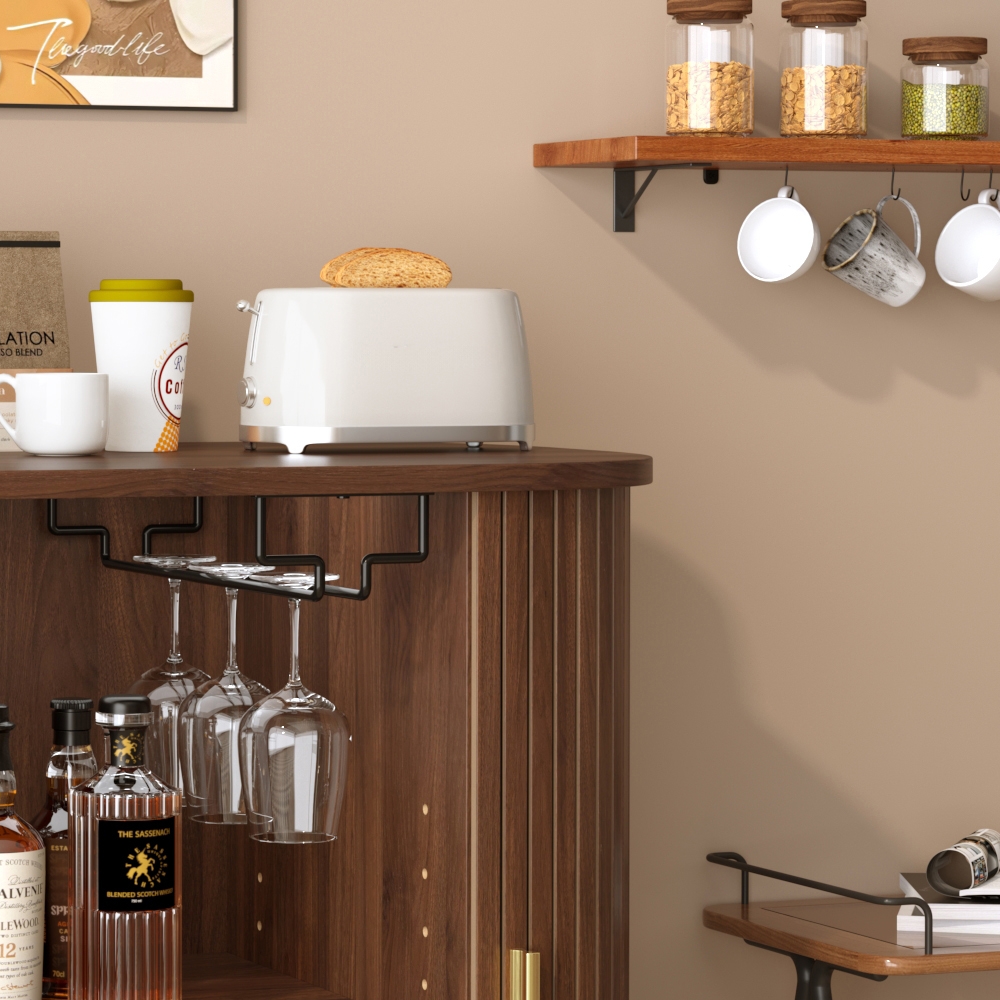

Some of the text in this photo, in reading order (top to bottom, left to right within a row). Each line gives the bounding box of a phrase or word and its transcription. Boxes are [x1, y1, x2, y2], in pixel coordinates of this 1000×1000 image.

[15, 348, 43, 357] BLEND
[117, 827, 171, 838] THE SASSENACH
[136, 890, 159, 898] SCOTCH
